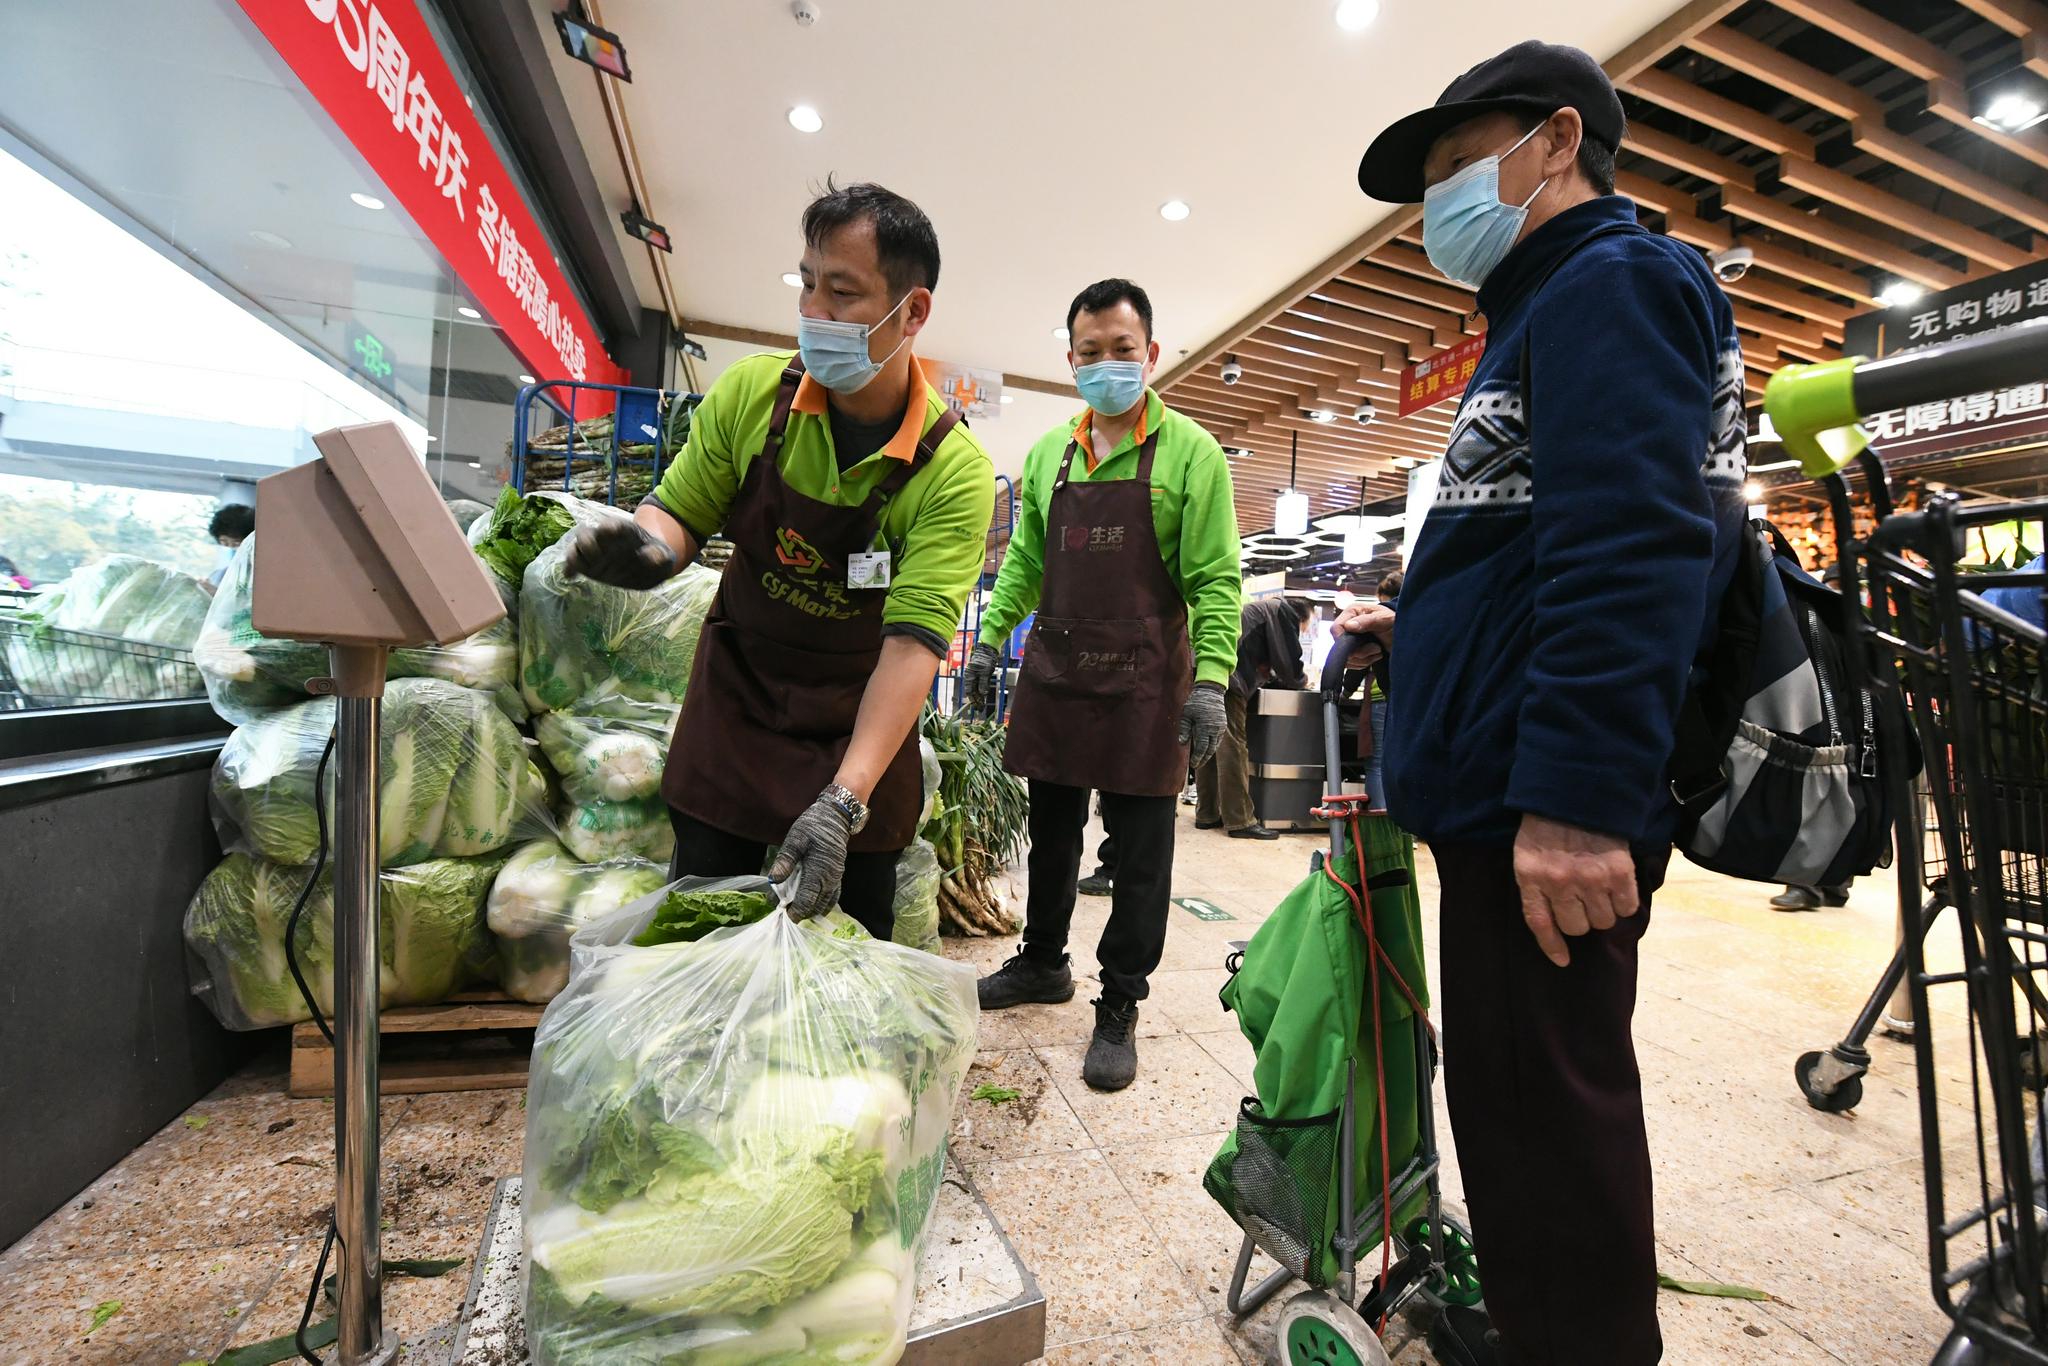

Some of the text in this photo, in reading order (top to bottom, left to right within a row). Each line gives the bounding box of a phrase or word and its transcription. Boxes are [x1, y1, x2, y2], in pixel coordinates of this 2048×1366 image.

[304, 0, 470, 223] 5周年庆
[1409, 357, 1477, 401] 结算专用
[1864, 382, 2048, 440] 无障碍通
[1089, 526, 1125, 544] 生活
